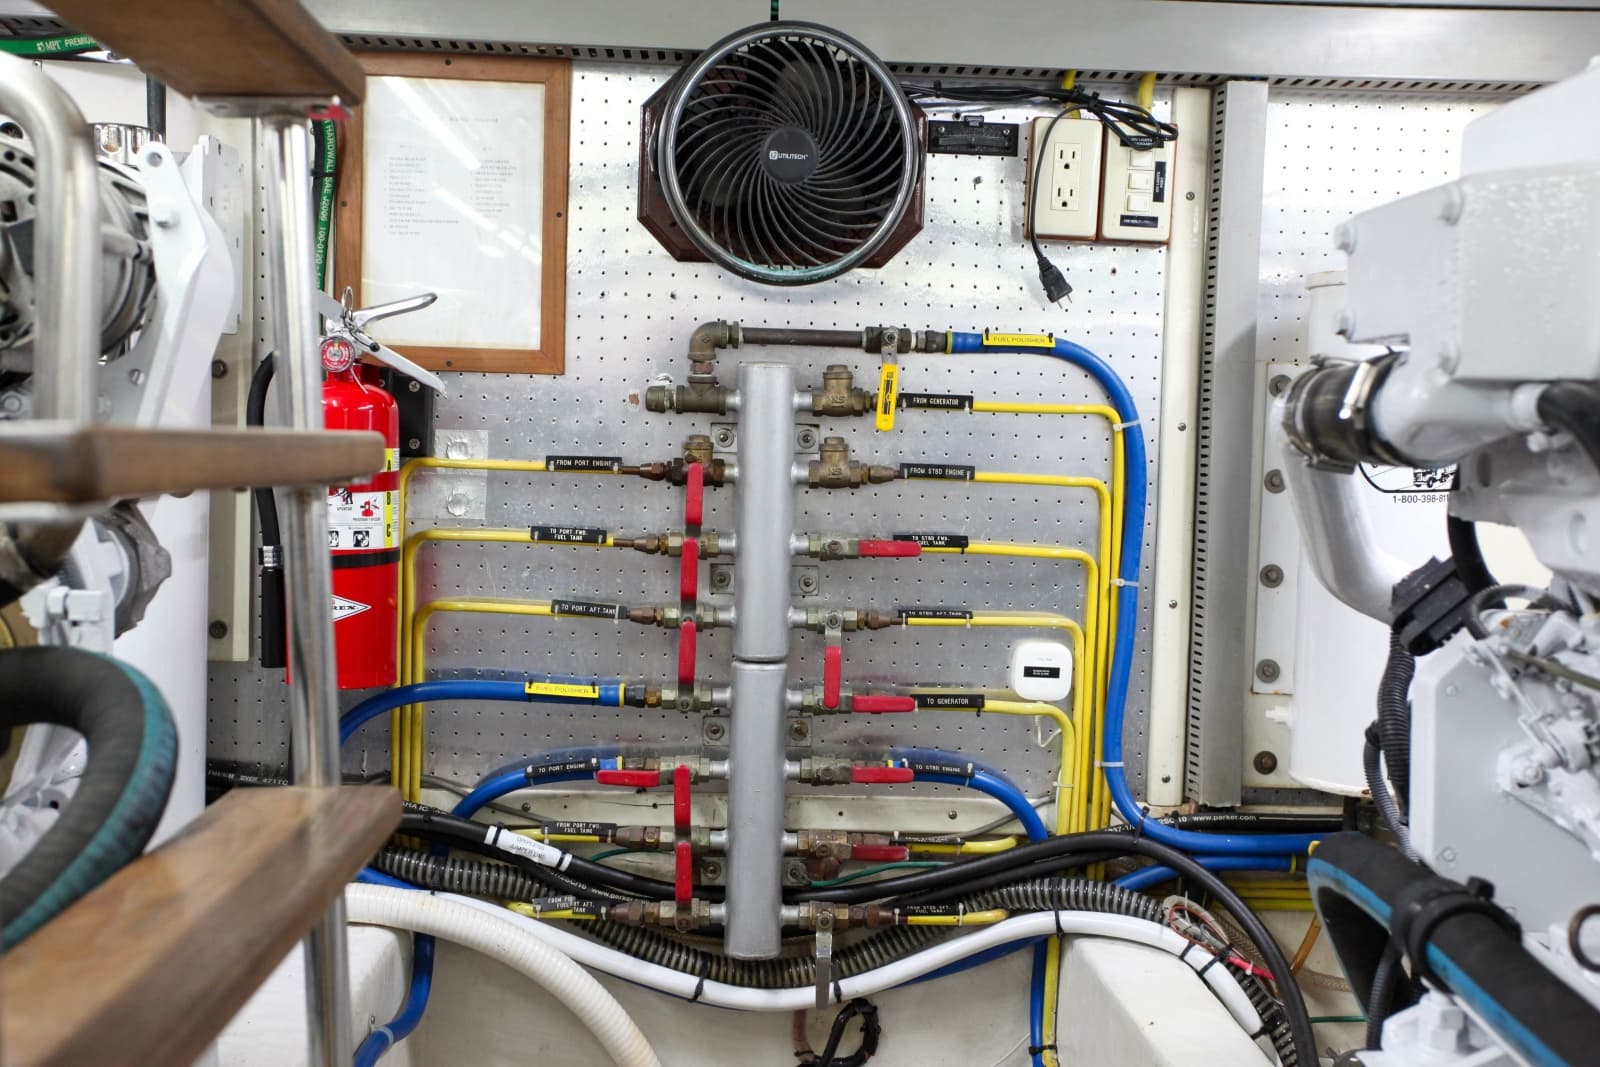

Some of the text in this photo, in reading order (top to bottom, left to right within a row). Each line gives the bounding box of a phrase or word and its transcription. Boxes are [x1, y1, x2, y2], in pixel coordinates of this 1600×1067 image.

[326, 124, 337, 173] HARDWALL
[993, 336, 1010, 344] FUEL
[912, 396, 959, 406] FROM GENERATOR
[945, 468, 965, 476] ENGINE
[1192, 814, 1257, 822] www.parker.com
